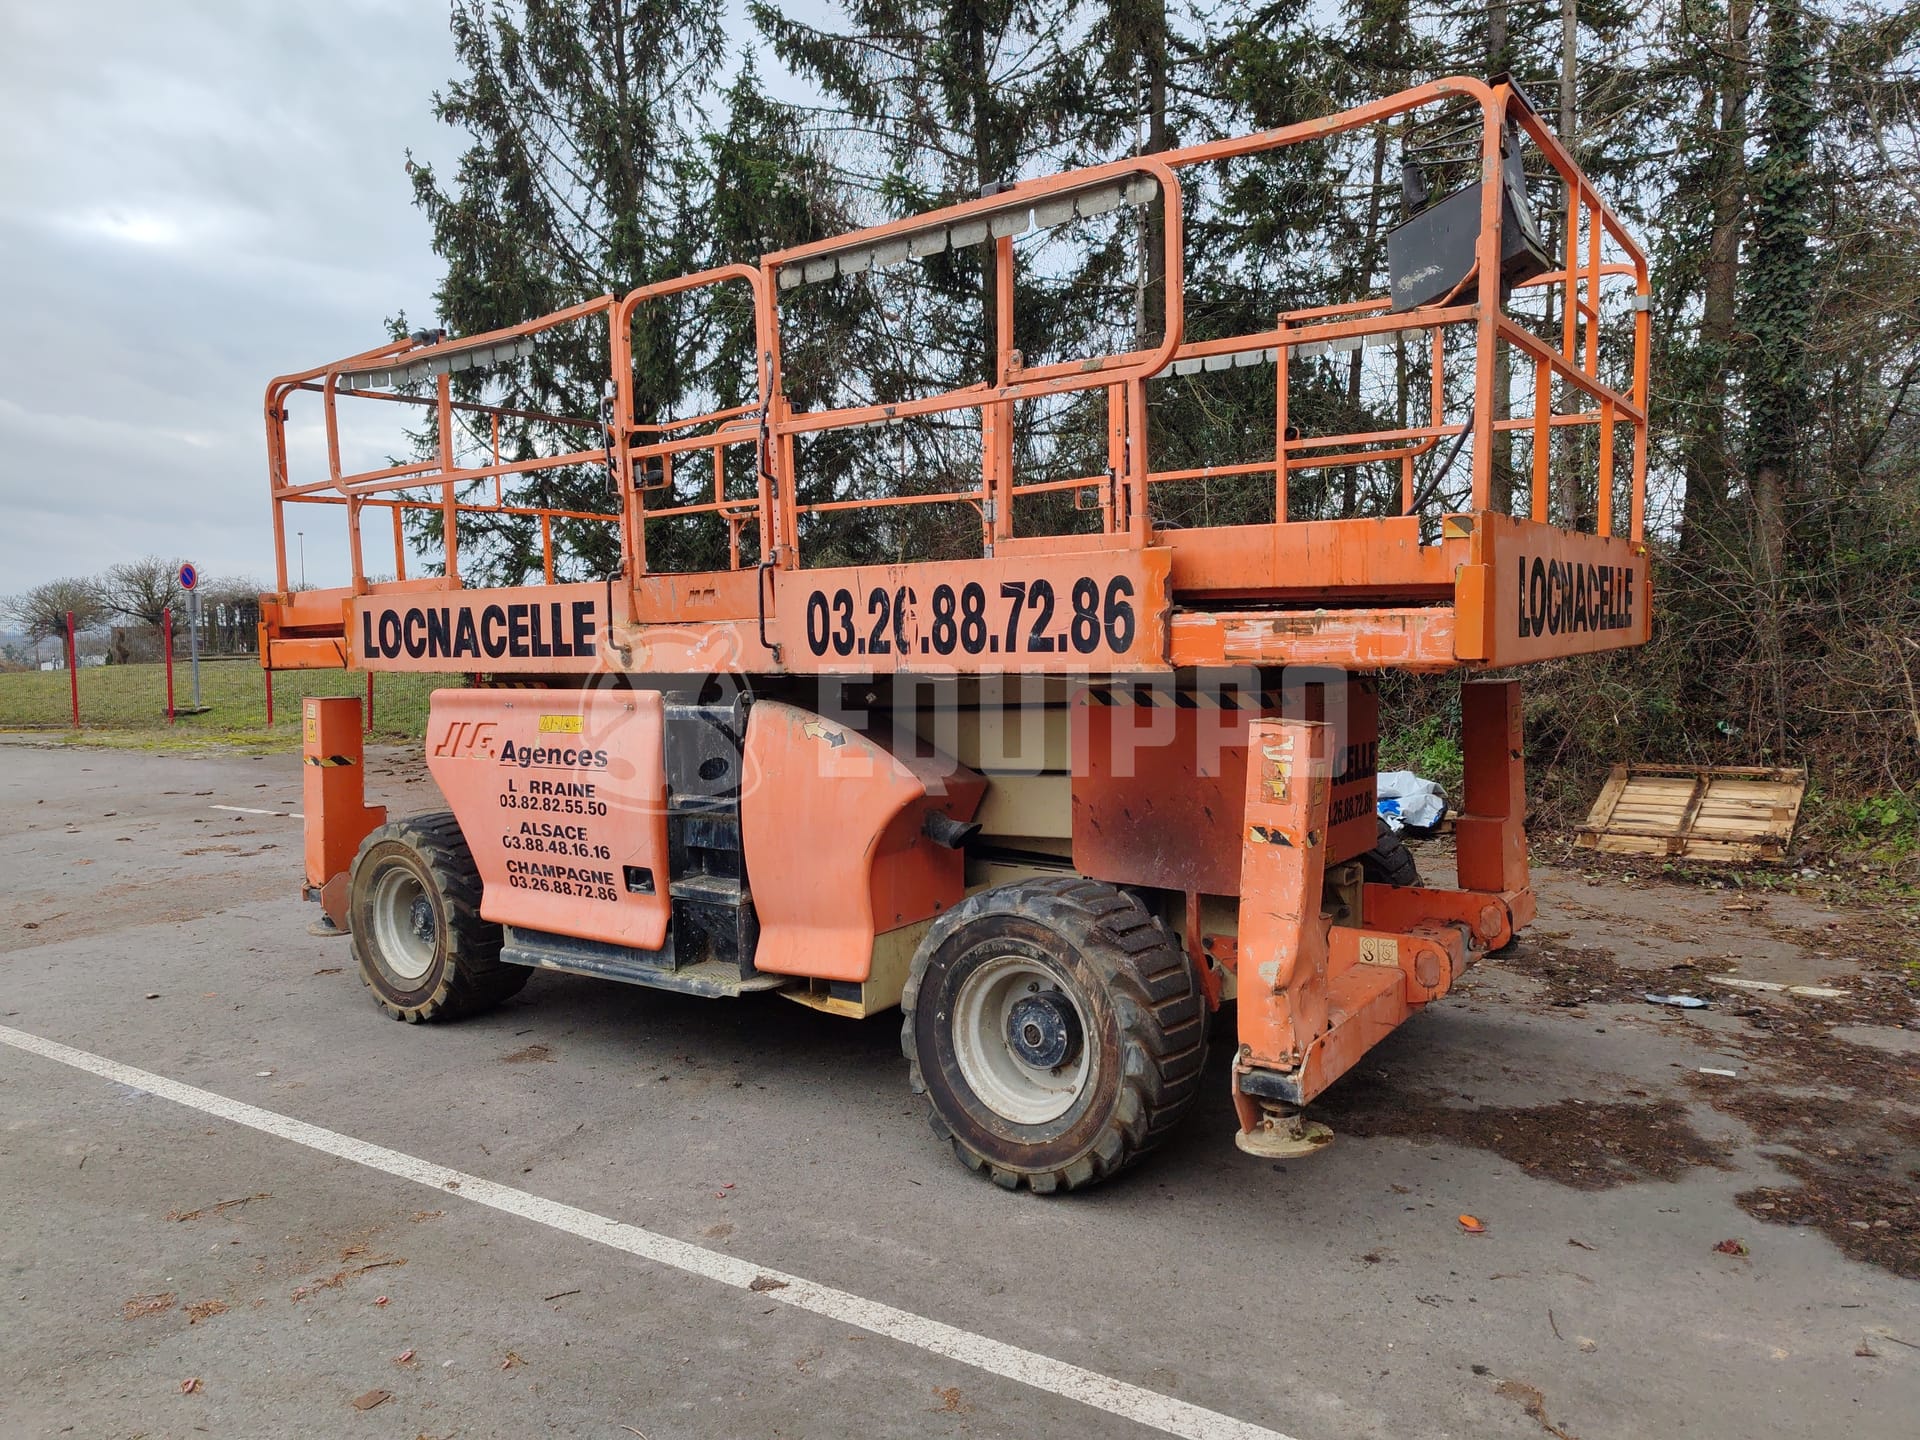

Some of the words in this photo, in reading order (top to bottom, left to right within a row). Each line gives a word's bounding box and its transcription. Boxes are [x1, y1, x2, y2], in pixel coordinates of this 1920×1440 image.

[1518, 556, 1634, 638] LOCNACELLE
[363, 600, 596, 659] LOCNACELLE
[499, 740, 609, 769] Agences
[508, 778, 596, 800] LRRAINE
[499, 793, 608, 817] 03.82.82.55.50
[519, 821, 588, 842] ALSACE
[502, 835, 611, 861] 03.88.48.16.16
[506, 859, 615, 887] CHAMPAGNE
[509, 874, 618, 902] 03.26.88.72.86
